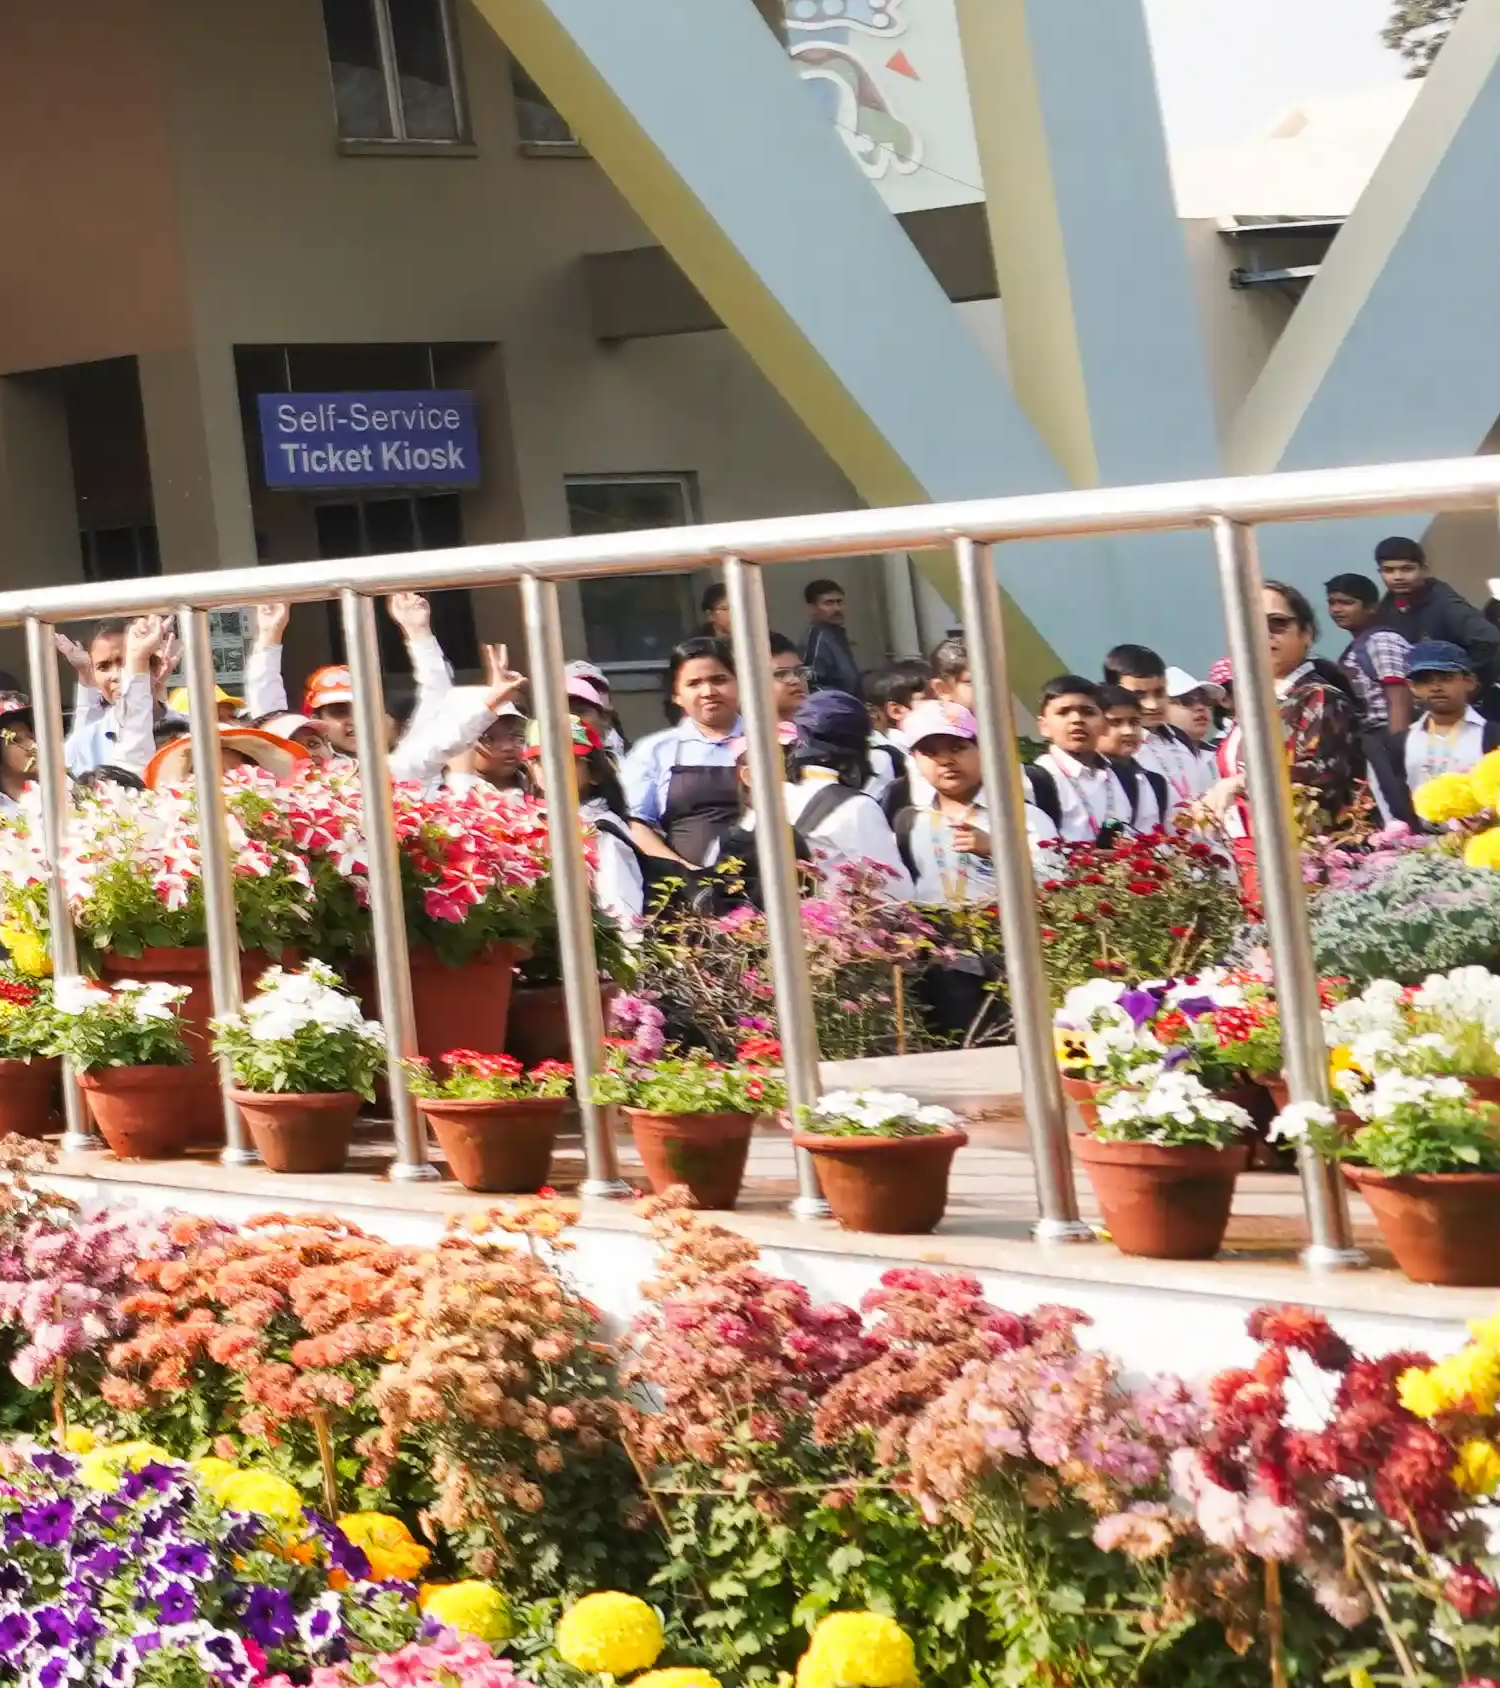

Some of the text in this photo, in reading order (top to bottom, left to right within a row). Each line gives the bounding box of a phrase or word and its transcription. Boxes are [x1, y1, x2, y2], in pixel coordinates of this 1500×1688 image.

[277, 402, 462, 434] Self-Service
[280, 440, 467, 474] Ticket Kiosk
